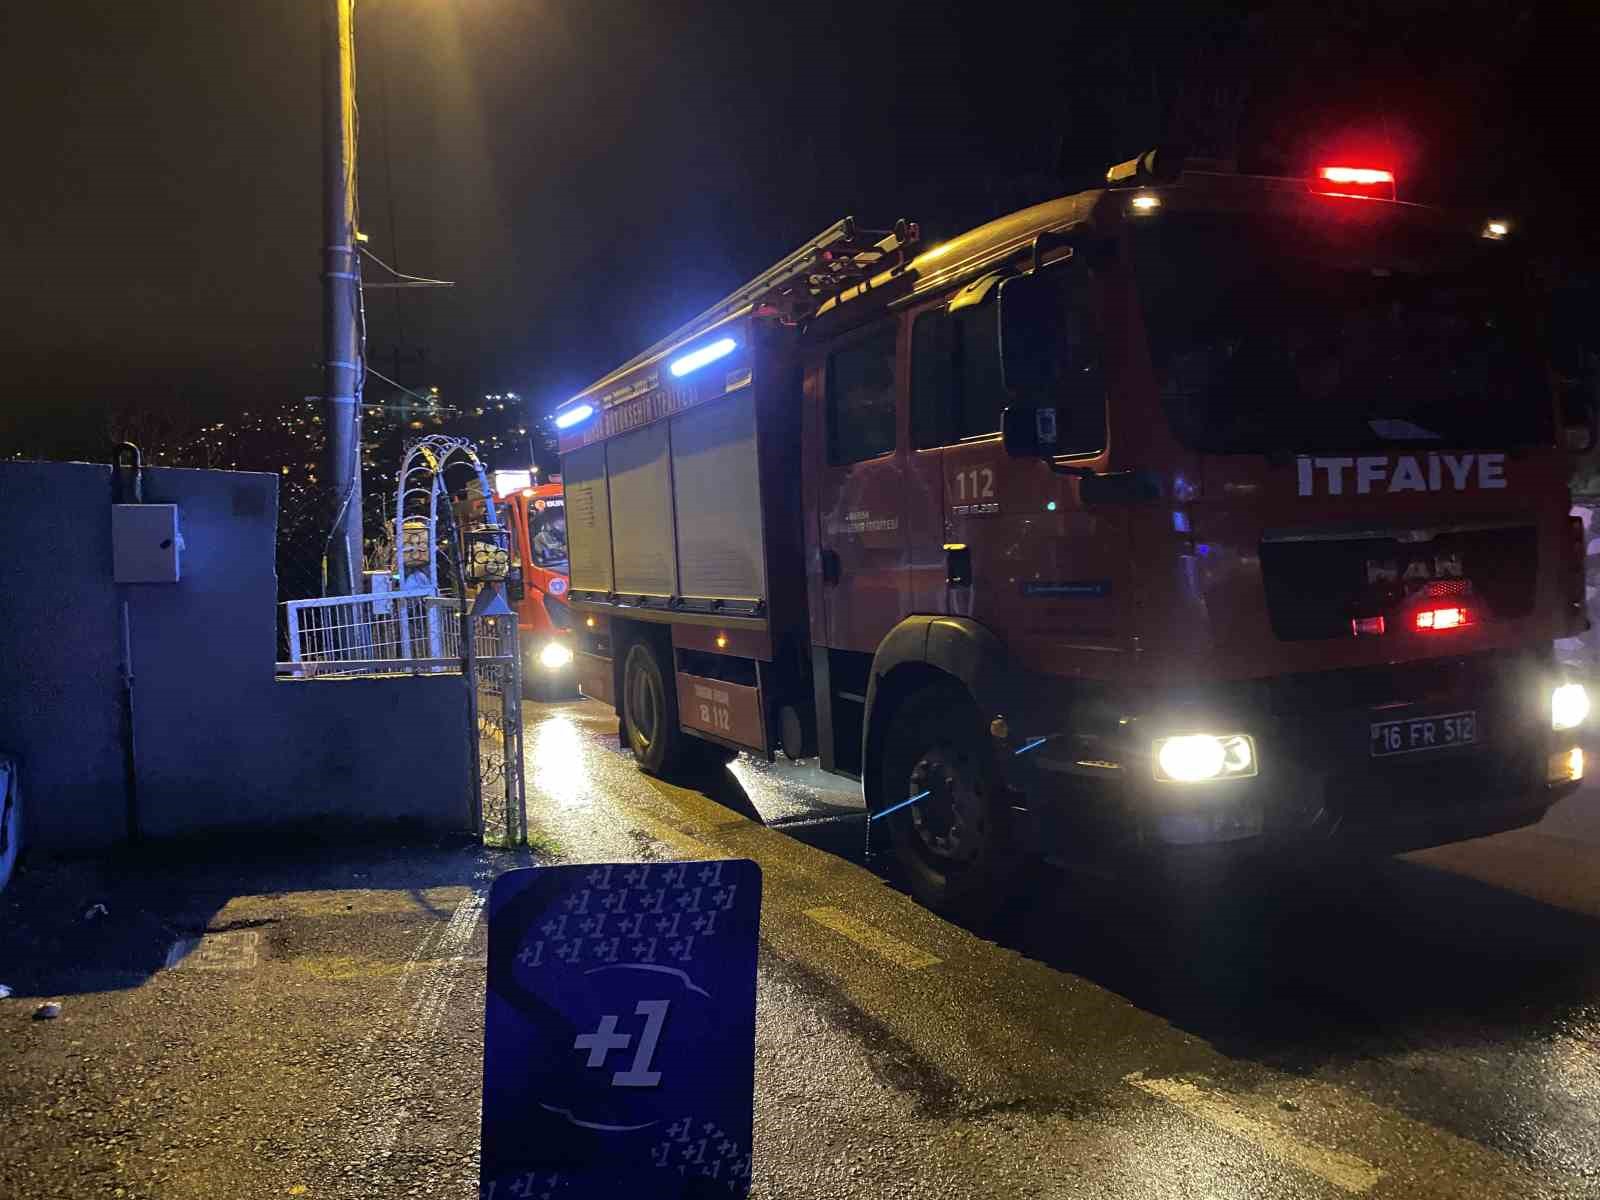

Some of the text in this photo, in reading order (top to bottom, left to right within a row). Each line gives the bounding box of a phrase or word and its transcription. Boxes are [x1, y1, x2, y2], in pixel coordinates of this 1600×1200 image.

[956, 468, 995, 500] 112
[1297, 453, 1507, 497] İTFAİYE
[1384, 725, 1401, 750] 16
[1410, 722, 1435, 746] FR
[1444, 717, 1473, 741] 512
[586, 863, 722, 889] +1 +1 +1 +1
[564, 884, 736, 914] +1 +1 +1 +1 +1
[541, 911, 717, 940] +1 +1 +1 +1 +1
[516, 936, 695, 967] +1 +1 +1 +1 +1
[574, 1000, 671, 1087] +1
